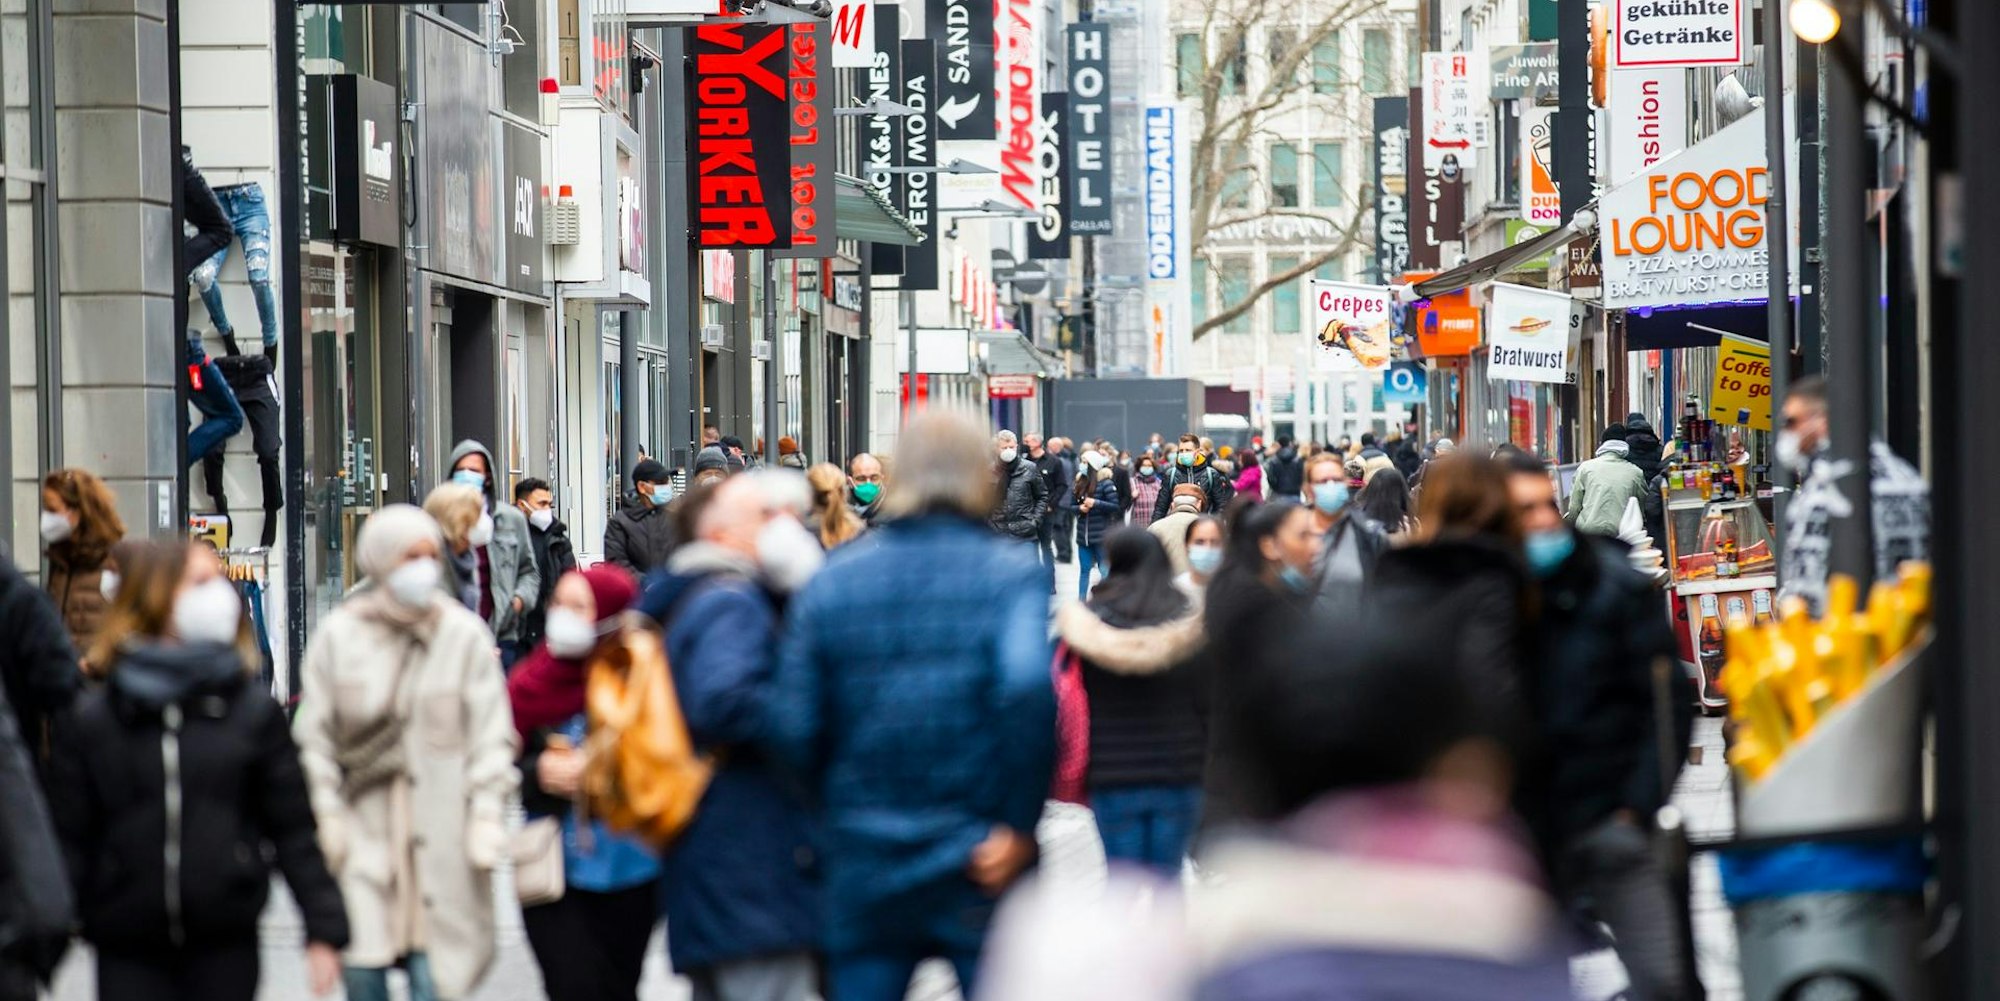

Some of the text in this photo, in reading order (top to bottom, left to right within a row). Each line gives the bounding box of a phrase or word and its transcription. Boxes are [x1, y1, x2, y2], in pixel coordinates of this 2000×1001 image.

[1627, 0, 1729, 22] gekühlte
[1624, 27, 1733, 45] Getränke
[1508, 53, 1559, 68] Juweli
[1494, 72, 1530, 87] Fine
[1074, 30, 1103, 207] HOTEL
[907, 75, 928, 242] ERO MODA
[1036, 110, 1062, 242] GEOX
[1149, 109, 1173, 279] ODENDAHL
[1649, 167, 1768, 213] FOOD
[1612, 209, 1764, 256] LOUNG
[1627, 250, 1769, 276] PIZZA POMMES
[1609, 274, 1718, 299] BRATWURST
[1493, 345, 1563, 369] Bratwurst
[1722, 356, 1771, 378] Coffe
[1719, 376, 1771, 398] to go
